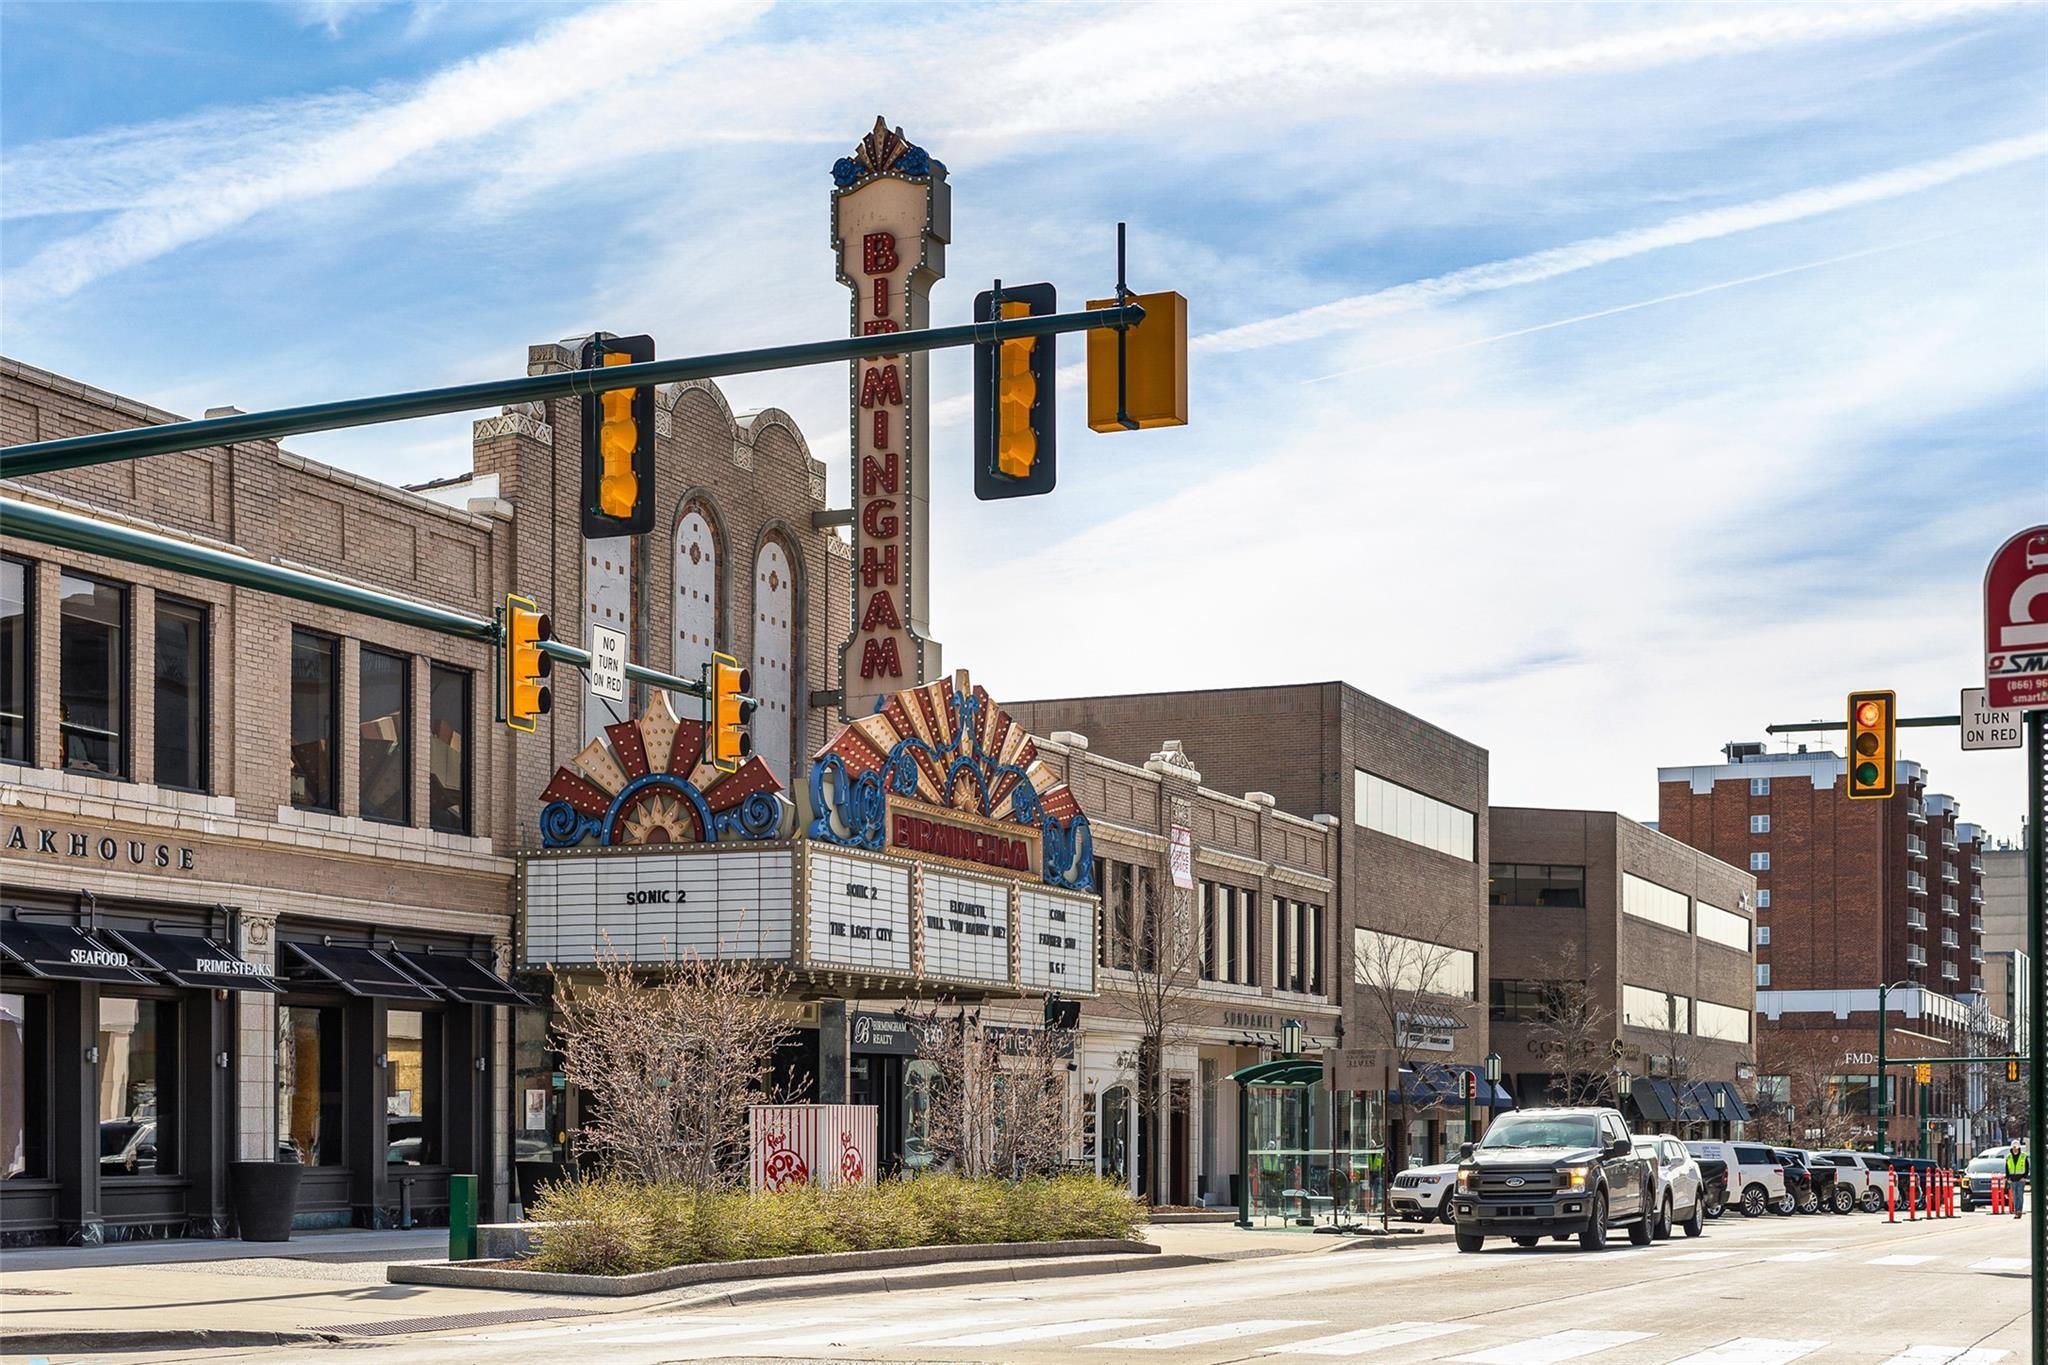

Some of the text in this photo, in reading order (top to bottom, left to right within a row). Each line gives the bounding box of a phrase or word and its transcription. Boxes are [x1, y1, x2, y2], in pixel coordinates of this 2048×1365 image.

[603, 636, 615, 651] NO
[598, 654, 618, 672] TURN
[594, 673, 621, 692] ON RED
[1974, 712, 2009, 725] TURN
[1967, 728, 2017, 742] ON RED
[6, 825, 195, 869] AKHOUSE
[892, 813, 1030, 871] BIRMINGHAM
[626, 890, 686, 905] SONIC 2
[846, 883, 878, 900] SONIC 2
[830, 922, 893, 942] THE LOST CITY
[927, 916, 945, 930] WILL
[949, 919, 963, 933] YOU
[71, 949, 128, 967] SEAFOOD
[196, 959, 272, 976] PRIME STEAKS
[872, 1021, 908, 1032] BIRMINGHAM
[873, 1034, 893, 1045] REALTY
[1845, 1053, 1873, 1064] FMD
